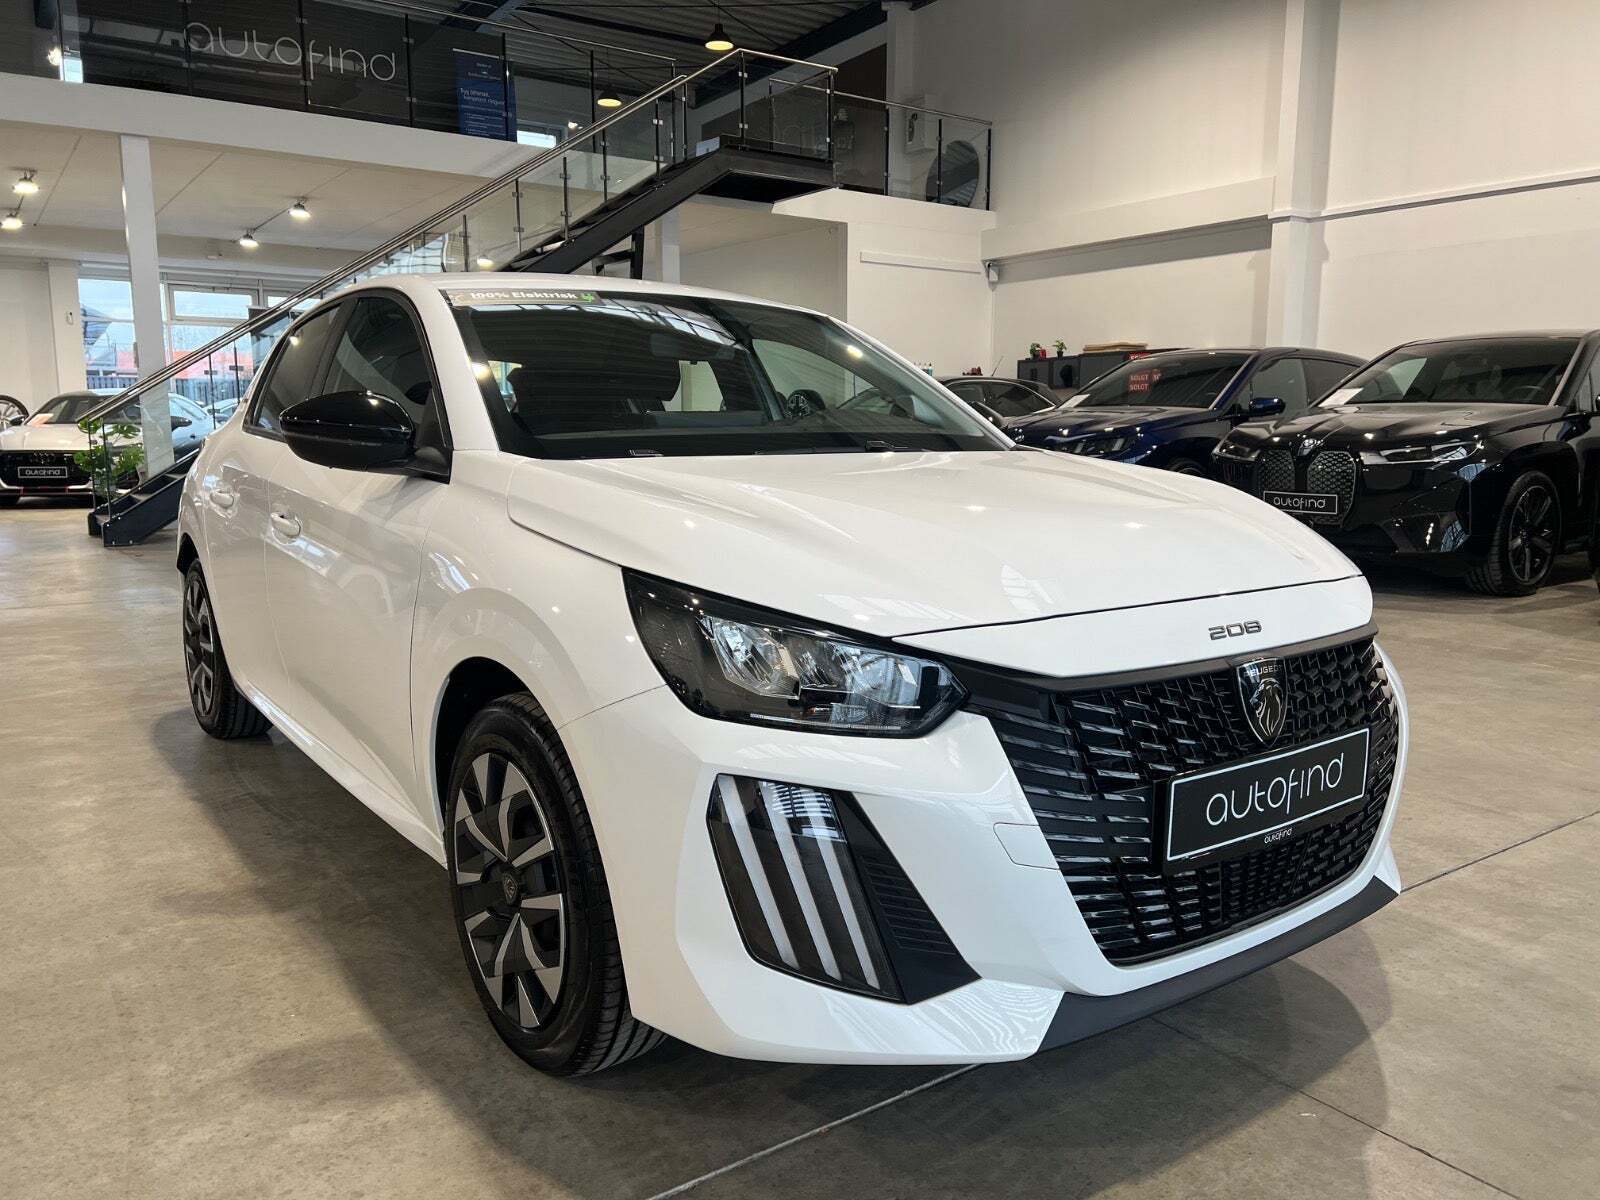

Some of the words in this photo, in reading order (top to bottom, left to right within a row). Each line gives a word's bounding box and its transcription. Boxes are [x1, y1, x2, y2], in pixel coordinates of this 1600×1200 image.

[184, 22, 395, 81] autofind
[470, 291, 509, 300] 100%
[1273, 496, 1326, 510] autofind
[1208, 620, 1262, 641] 208
[1206, 752, 1344, 826] autofind
[1264, 827, 1293, 844] autofind
